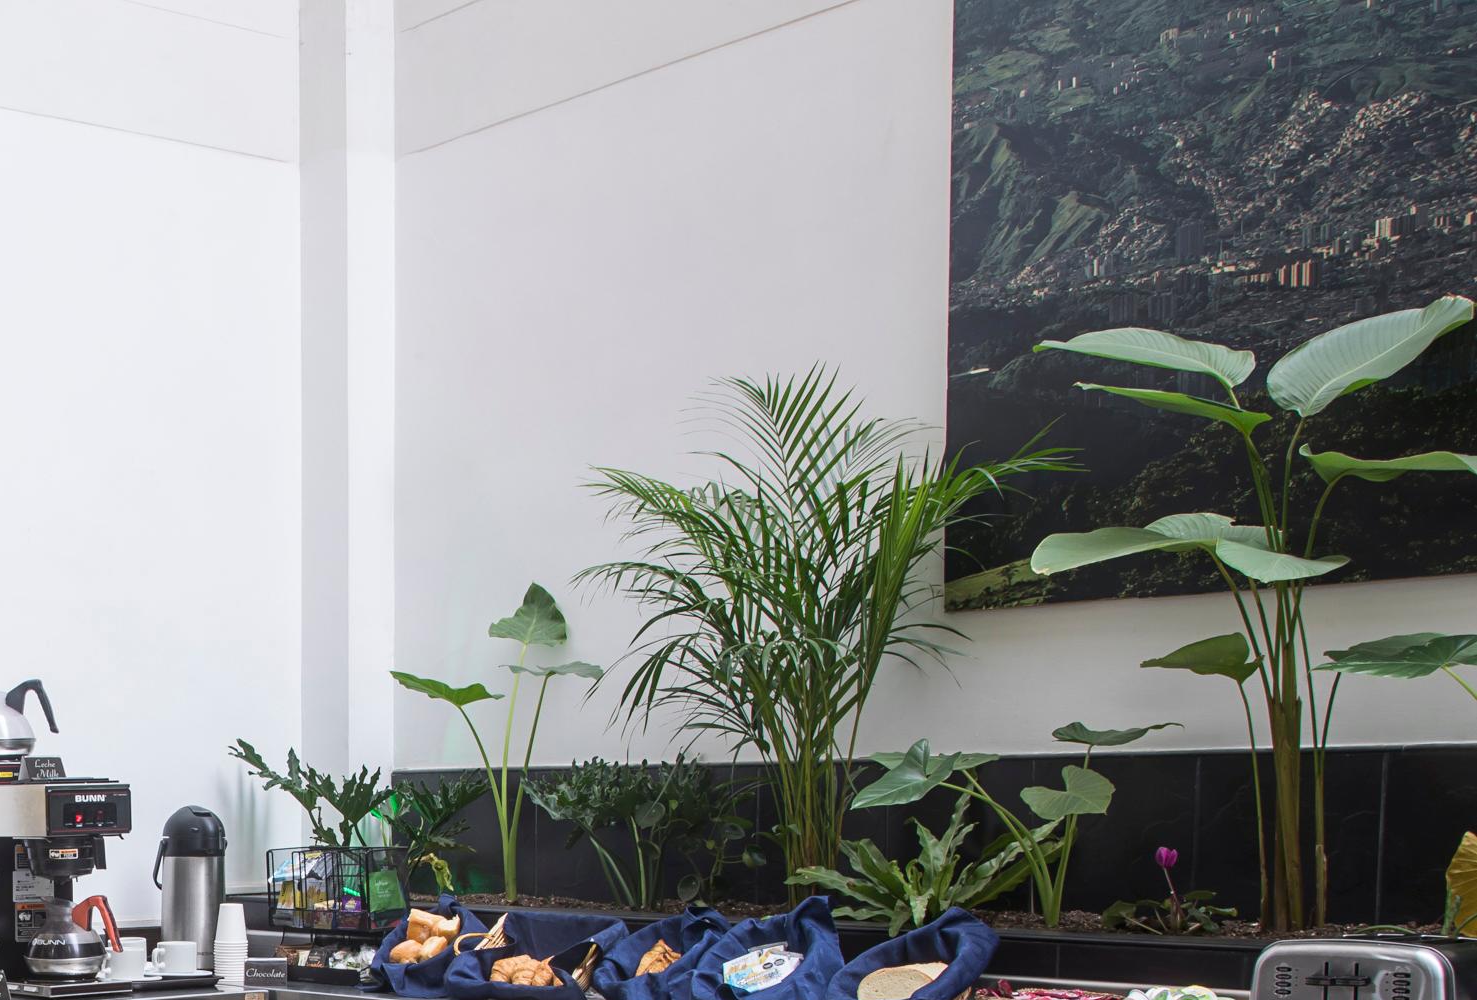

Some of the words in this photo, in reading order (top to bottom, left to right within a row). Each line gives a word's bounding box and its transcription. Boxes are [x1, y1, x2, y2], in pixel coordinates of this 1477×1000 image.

[34, 759, 56, 768] Leche
[74, 794, 105, 803] BUNN
[246, 967, 286, 978] Chocolate
